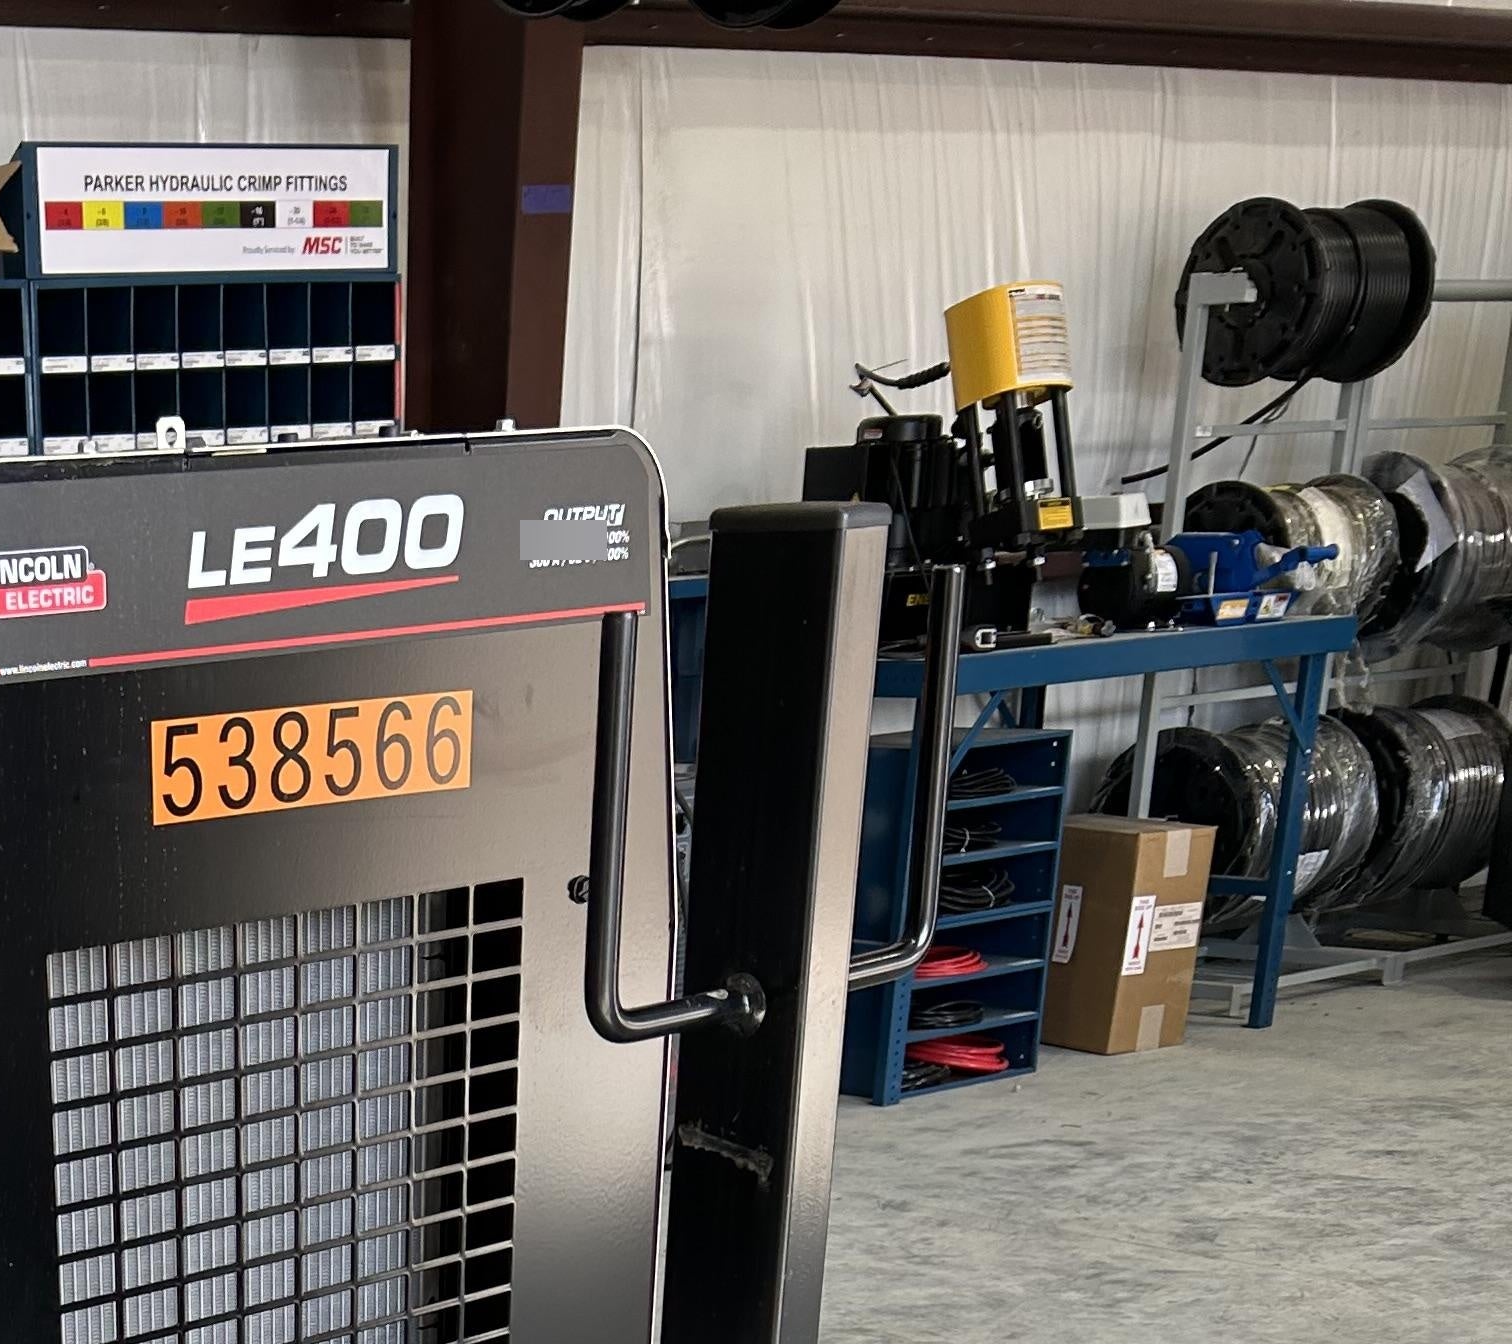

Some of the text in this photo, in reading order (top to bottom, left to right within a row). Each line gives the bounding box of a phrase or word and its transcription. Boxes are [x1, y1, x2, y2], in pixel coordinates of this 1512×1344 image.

[84, 175, 348, 192] PARKER HYDRAULIC CRIMP FITTINGS
[302, 236, 344, 254] MSC
[188, 494, 464, 589] LE400
[5, 585, 95, 611] ELECTRIC
[0, 659, 88, 676] www.lincolnelectric.com
[162, 695, 462, 817] 538566
